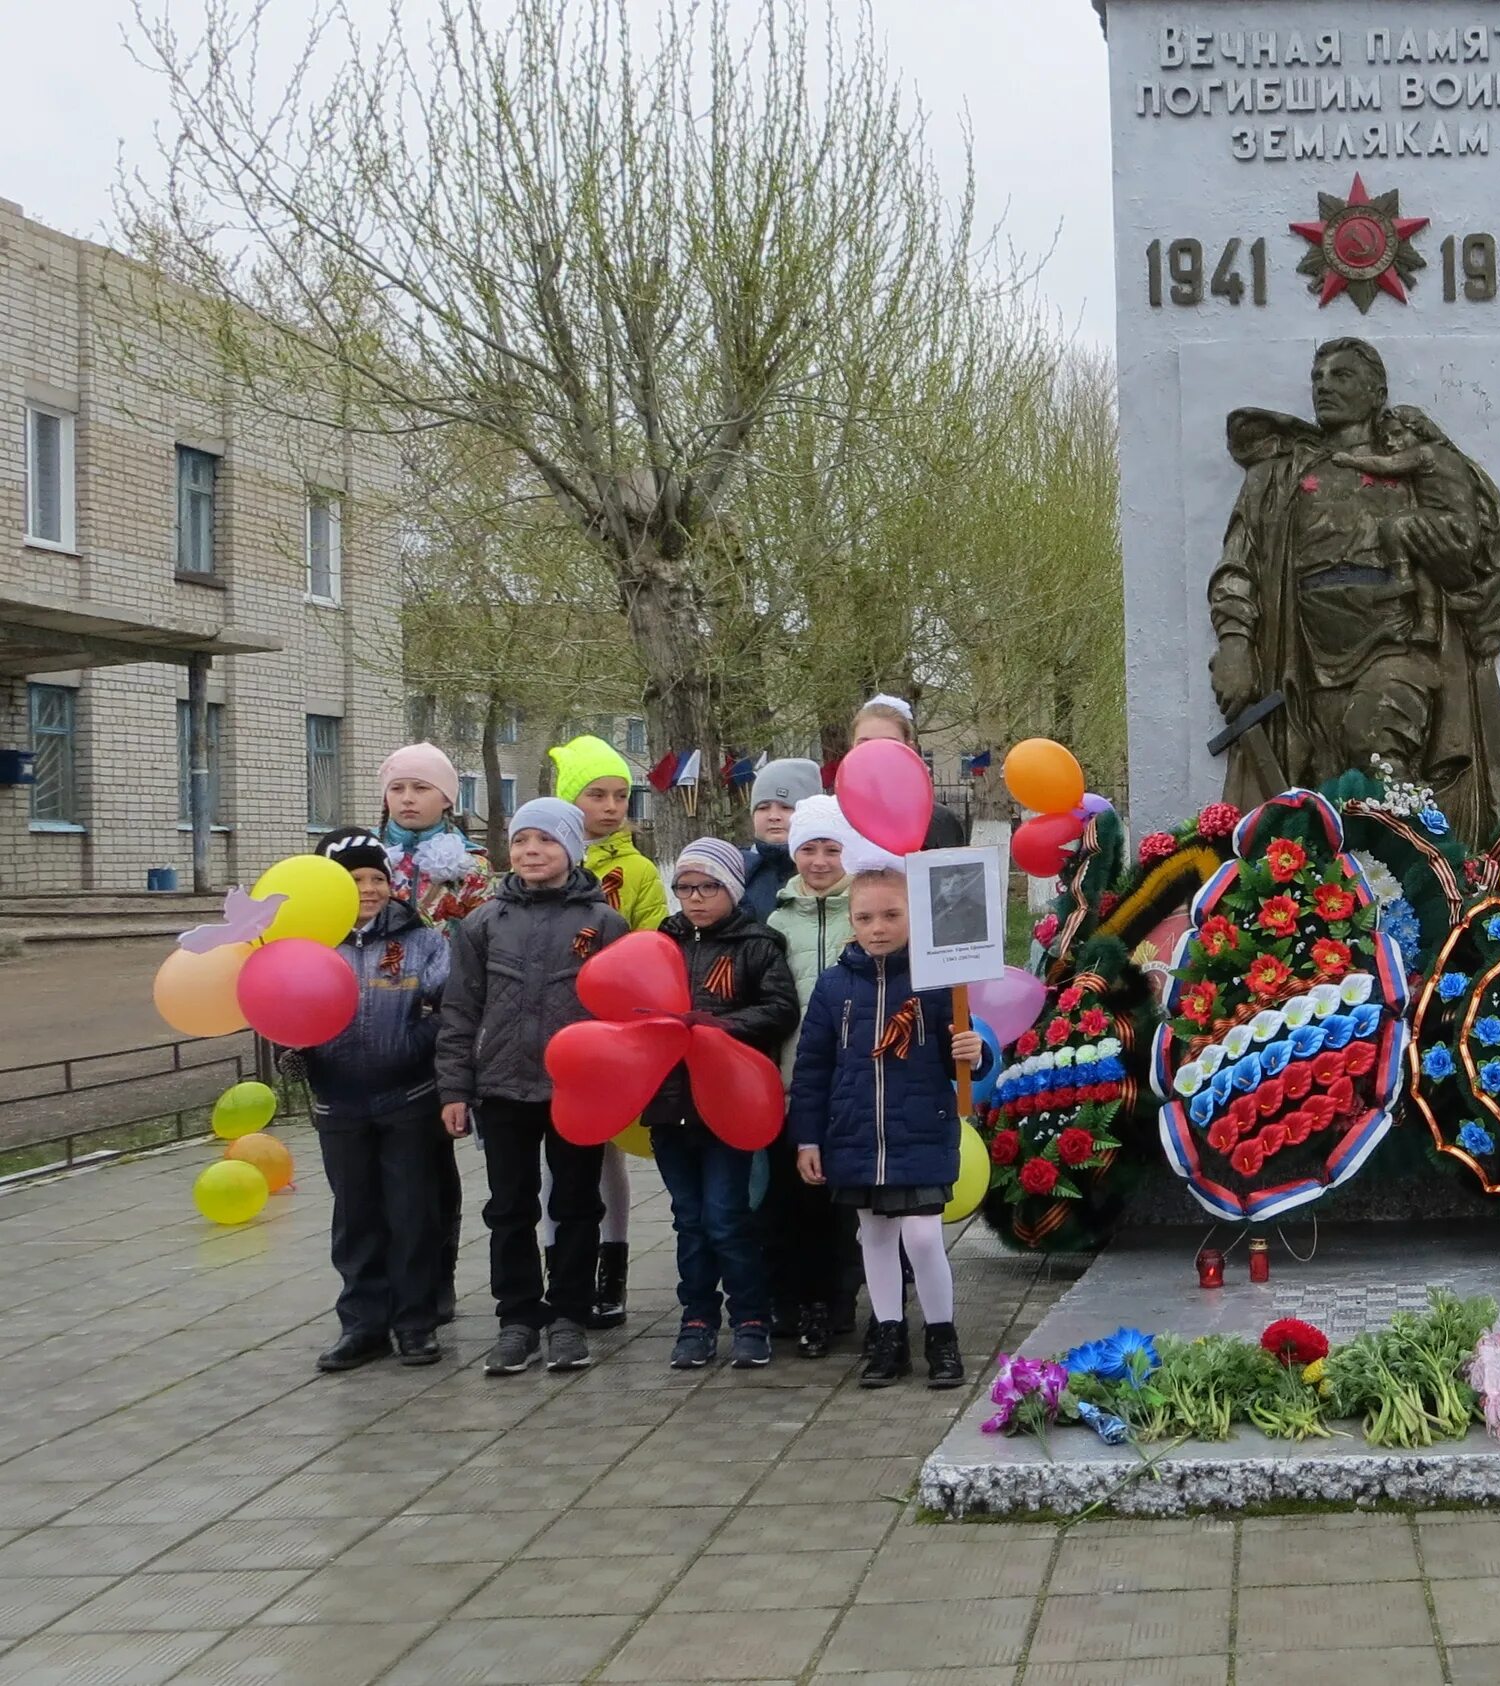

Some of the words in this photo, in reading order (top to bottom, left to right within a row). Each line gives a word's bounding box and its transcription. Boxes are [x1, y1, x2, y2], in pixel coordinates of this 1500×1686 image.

[1159, 27, 1342, 70] ВЕЧНАЯ
[1136, 74, 1382, 117] ПОГИБШИМ
[1231, 119, 1490, 161] ЗЕМЛЯКАМ
[1146, 236, 1268, 308] 1941
